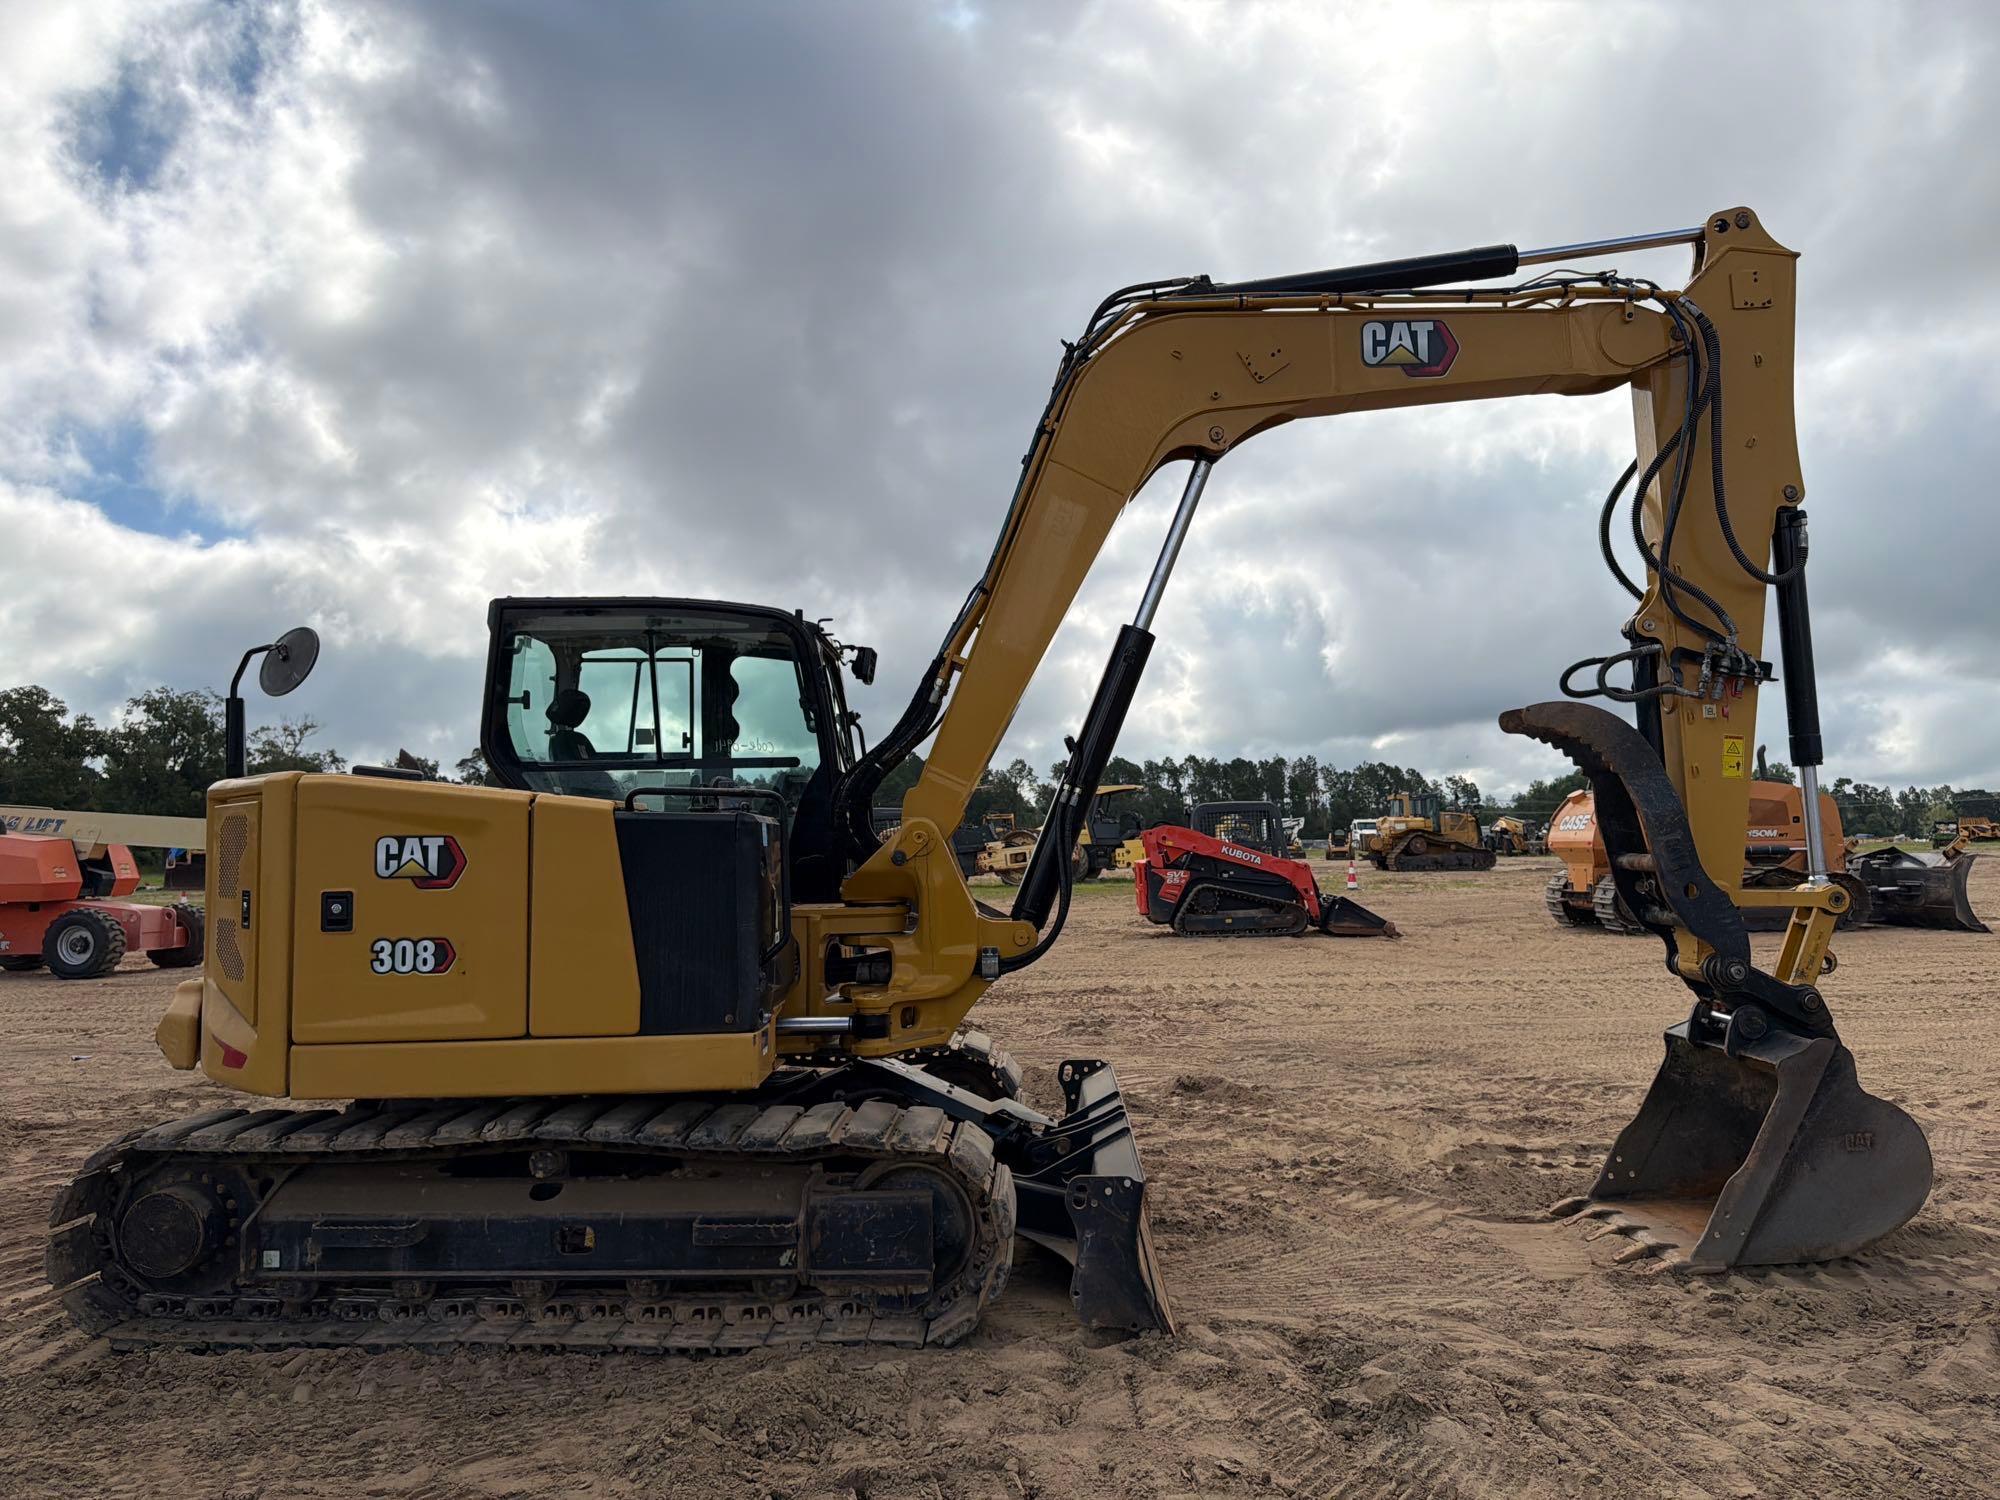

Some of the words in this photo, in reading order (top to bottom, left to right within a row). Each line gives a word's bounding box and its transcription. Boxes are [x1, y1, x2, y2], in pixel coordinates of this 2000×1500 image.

[1362, 321, 1434, 365] CAT
[25, 817, 67, 833] LIFT
[1559, 815, 1592, 831] CASE
[1745, 829, 1778, 838] 150M
[376, 836, 445, 878] CAT
[1221, 845, 1262, 865] KUBOTA
[372, 939, 436, 973] 308
[1845, 1132, 1873, 1151] CAT
